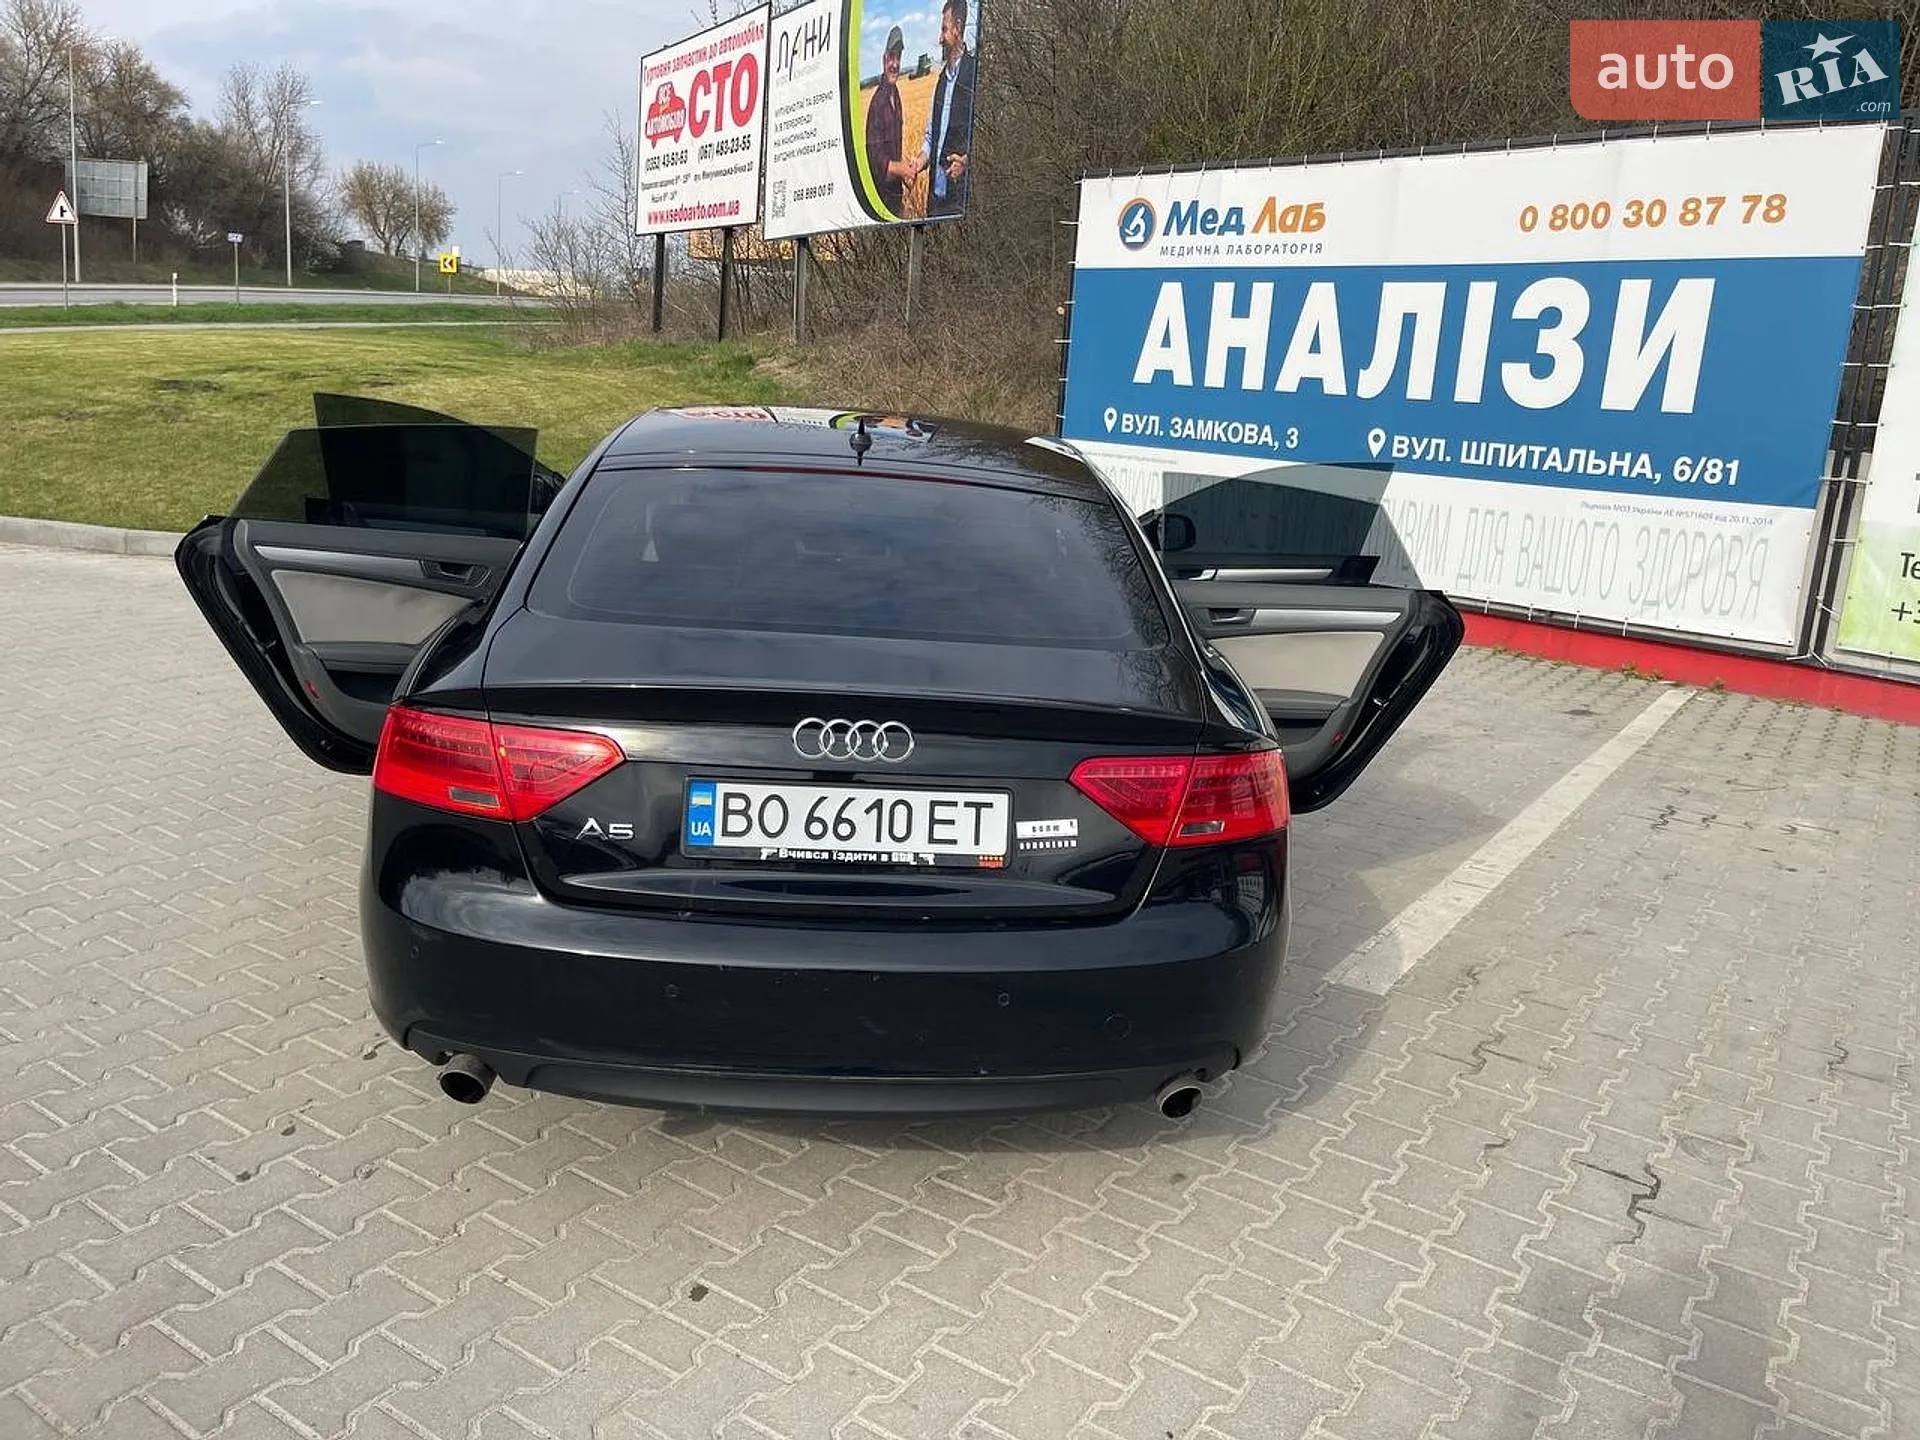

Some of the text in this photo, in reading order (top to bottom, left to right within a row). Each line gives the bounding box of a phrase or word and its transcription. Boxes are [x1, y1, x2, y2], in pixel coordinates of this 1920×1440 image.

[689, 53, 759, 138] СТО
[1162, 195, 1327, 237] Мед Лаб
[1519, 193, 1788, 233] 0 800 30 87 78
[1159, 242, 1324, 257] МЕДИЧНА ЛАБОРАТОРІЯ
[1132, 276, 1716, 415] АНАЛІЗИ
[1120, 413, 1299, 451] ВУЛ. ЗАМКОВА, 3
[1391, 434, 1741, 487] ВУЛ. ШПИТАЛЬНА, 6/81
[1456, 506, 1510, 590] ДЛЯ
[1515, 512, 1620, 602] ВАШОГО
[576, 817, 634, 840] A5
[690, 821, 712, 837] UA
[721, 792, 994, 847] BO 6610 ET
[779, 848, 829, 861] Вчився
[832, 850, 877, 863] їздити
